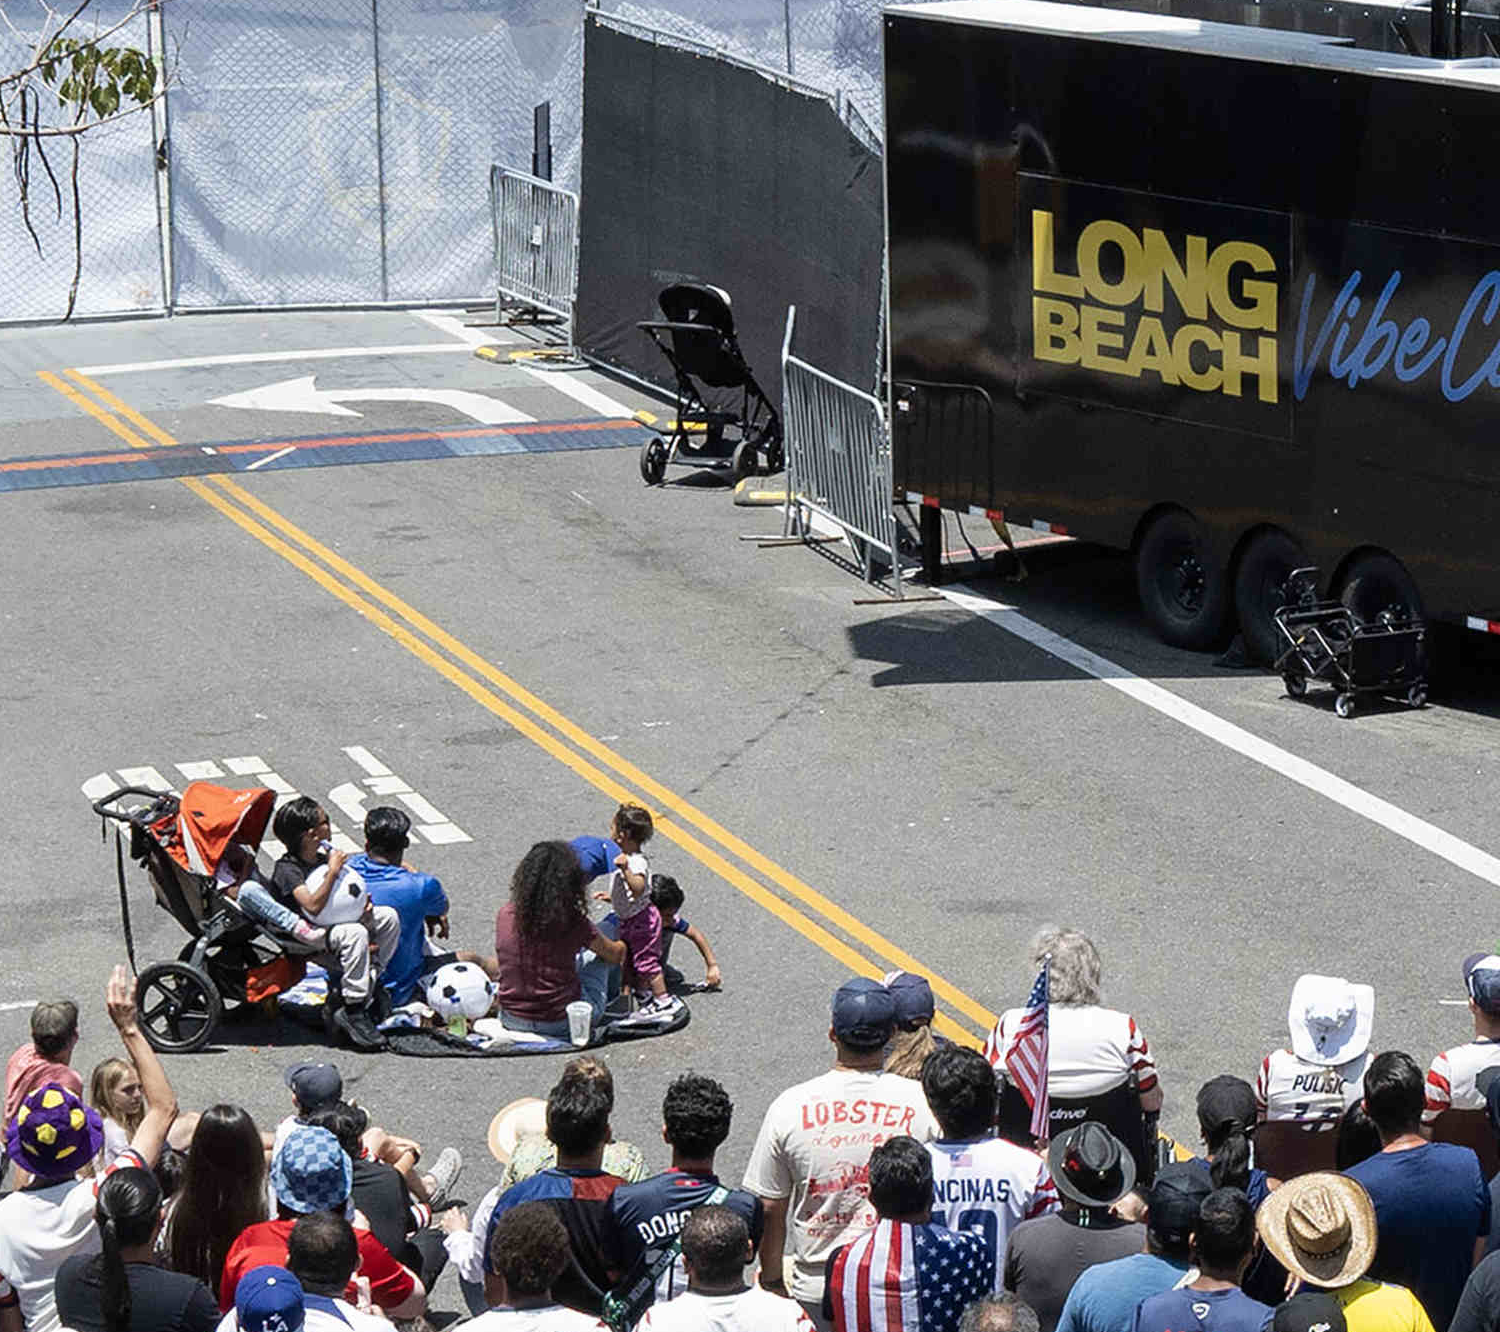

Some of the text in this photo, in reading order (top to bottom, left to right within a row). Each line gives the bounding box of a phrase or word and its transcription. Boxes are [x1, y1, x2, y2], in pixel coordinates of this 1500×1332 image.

[1033, 209, 1278, 333] LONG
[1033, 297, 1278, 404] BEACH
[1293, 269, 1443, 402] Vibe
[801, 1100, 916, 1136] LOBSTER
